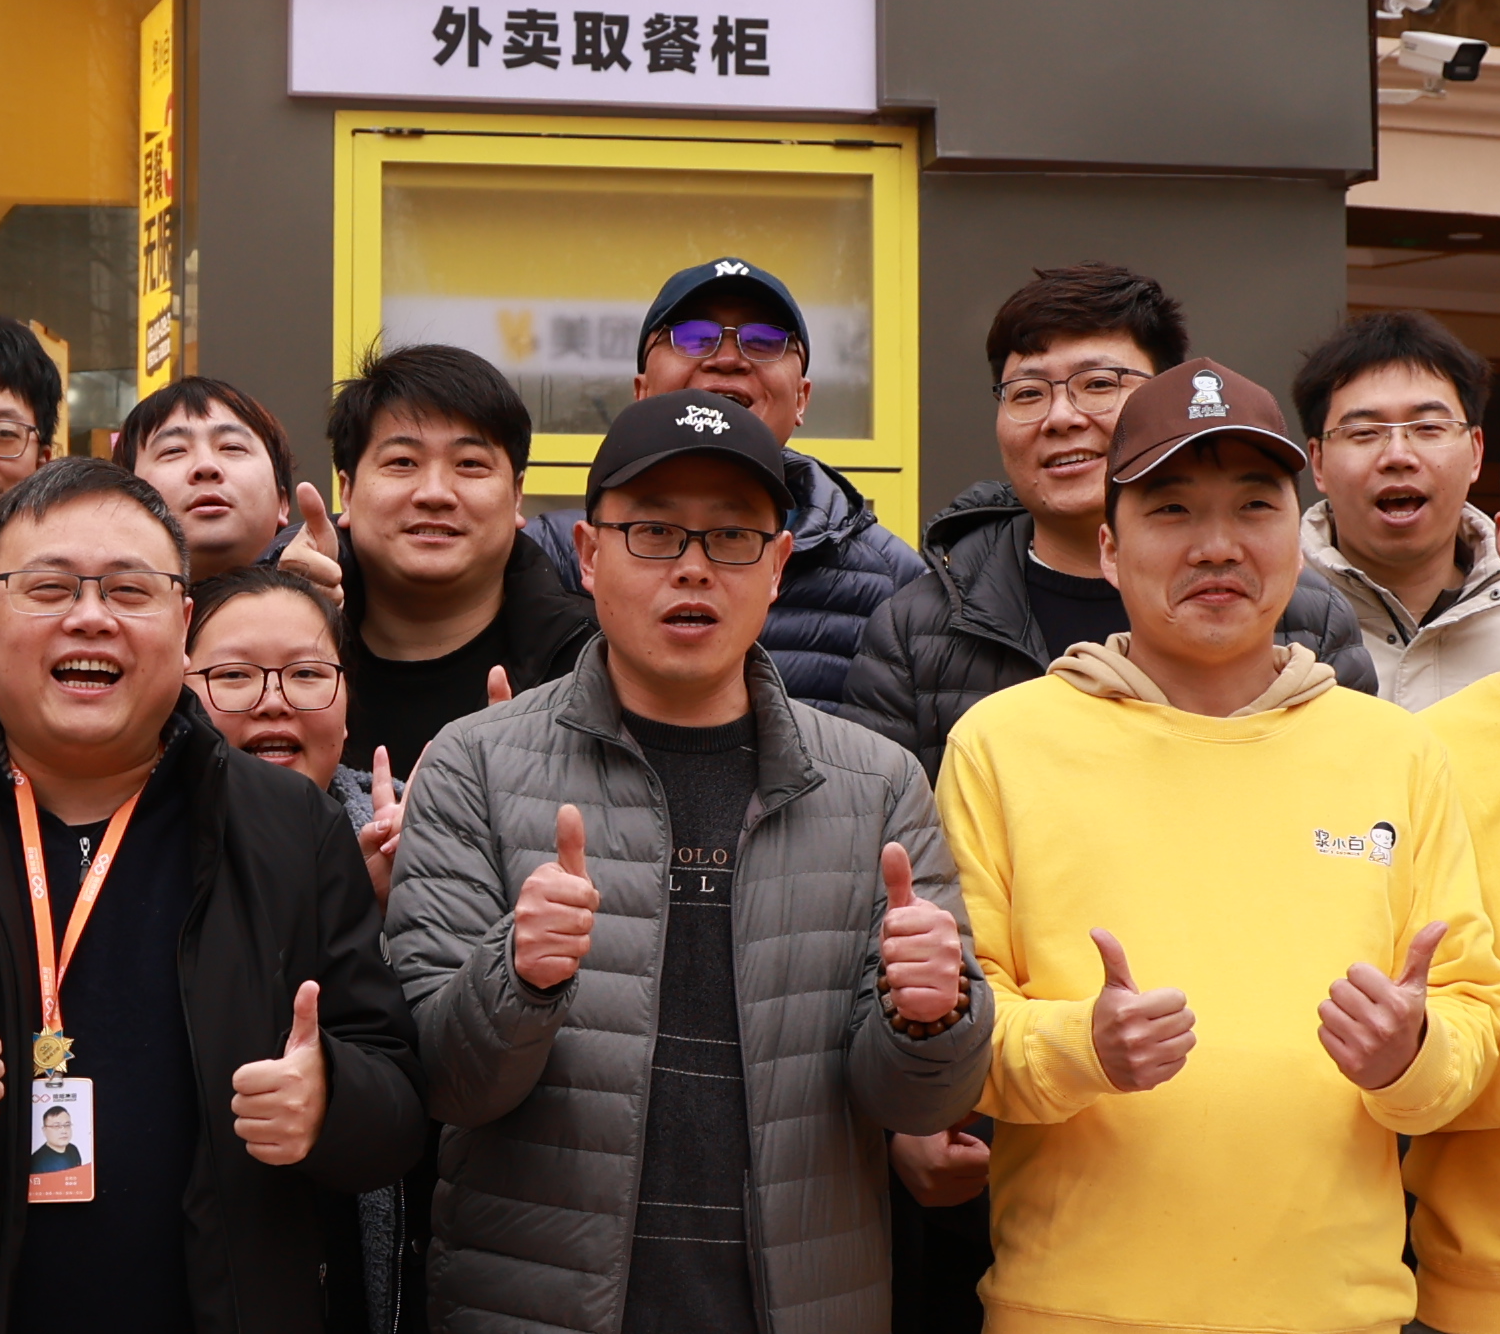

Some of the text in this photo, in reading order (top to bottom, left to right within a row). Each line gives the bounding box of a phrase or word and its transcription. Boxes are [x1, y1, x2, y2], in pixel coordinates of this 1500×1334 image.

[431, 5, 770, 77] 外卖取餐柜
[671, 846, 729, 865] OLO
